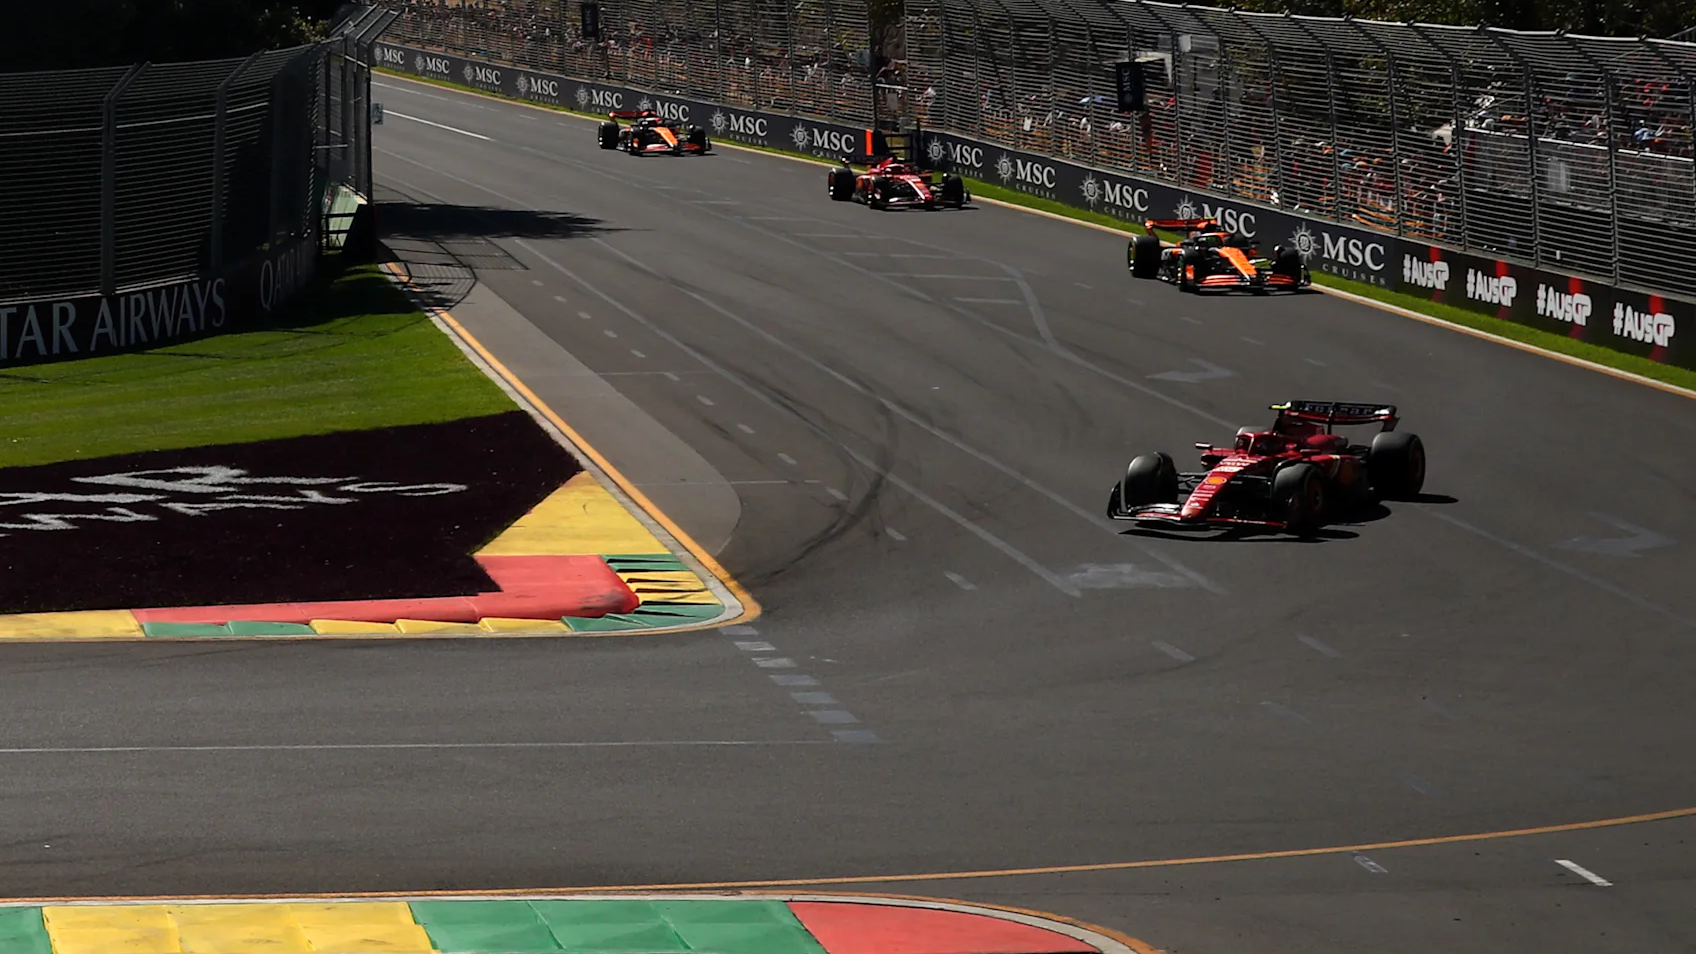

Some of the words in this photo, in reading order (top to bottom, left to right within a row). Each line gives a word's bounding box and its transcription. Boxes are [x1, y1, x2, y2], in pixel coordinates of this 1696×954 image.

[383, 47, 404, 64] MSC
[426, 56, 450, 74] MSC
[475, 66, 501, 85] MSC
[530, 77, 559, 96] MSC
[1121, 67, 1131, 92] MSC
[591, 89, 623, 109] MSC
[656, 100, 689, 122] MSC
[729, 113, 768, 137] MSC
[812, 128, 855, 153] MSC
[946, 142, 984, 168] MSC
[1015, 159, 1056, 188] MSC
[1103, 179, 1149, 212] MSC
[1202, 203, 1256, 238] MSC
[1321, 232, 1385, 271] MSC
[1322, 263, 1386, 285] CRUISES
[90, 277, 226, 350] AIRWAYS
